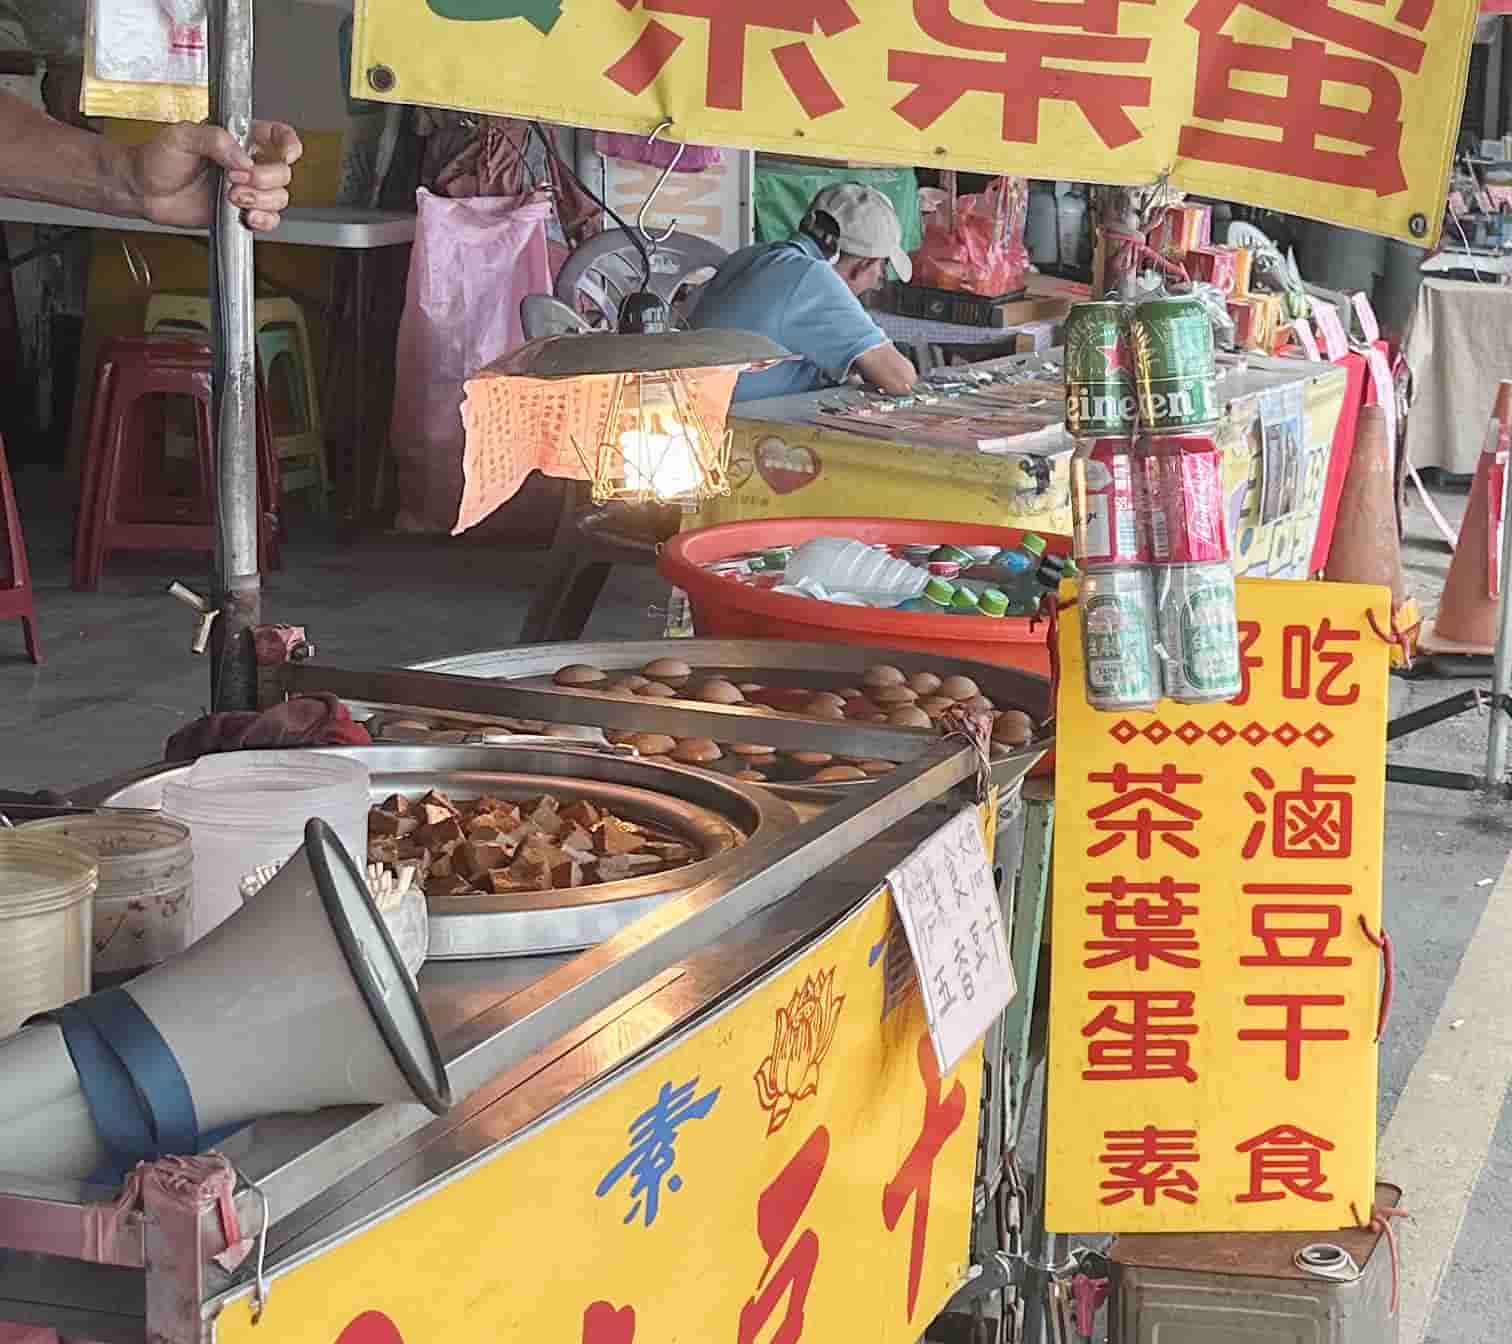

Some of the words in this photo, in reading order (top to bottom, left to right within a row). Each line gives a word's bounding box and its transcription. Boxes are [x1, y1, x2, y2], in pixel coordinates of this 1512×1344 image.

[1081, 763, 1202, 1084] 茶葉蛋
[1237, 766, 1357, 1082] 滷豆干
[1099, 1123, 1335, 1205] 素食
